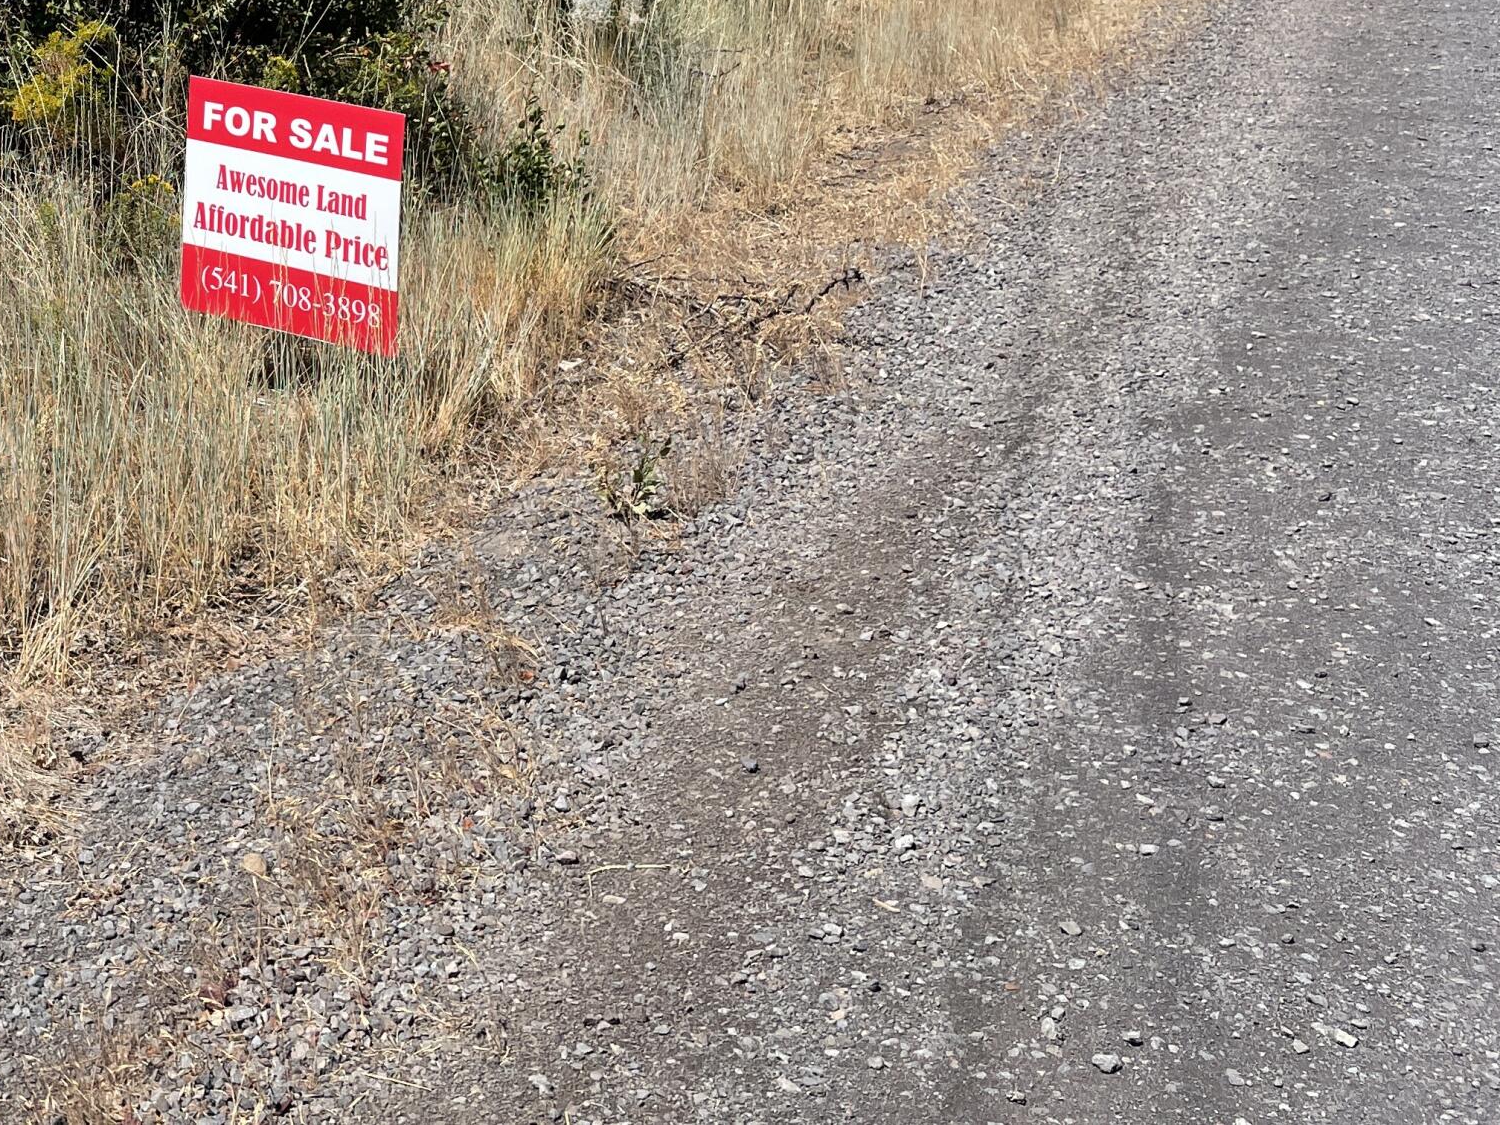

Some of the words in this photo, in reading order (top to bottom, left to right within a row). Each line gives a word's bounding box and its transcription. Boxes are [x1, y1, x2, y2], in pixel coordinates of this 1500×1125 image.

[203, 101, 277, 143] FOR
[289, 118, 389, 165] SALE
[216, 164, 310, 207] Awesome
[316, 185, 367, 221] Land
[193, 202, 317, 254] Affordable
[325, 230, 389, 271] Price
[201, 265, 261, 303] (541)
[269, 280, 381, 328] 708-3898
